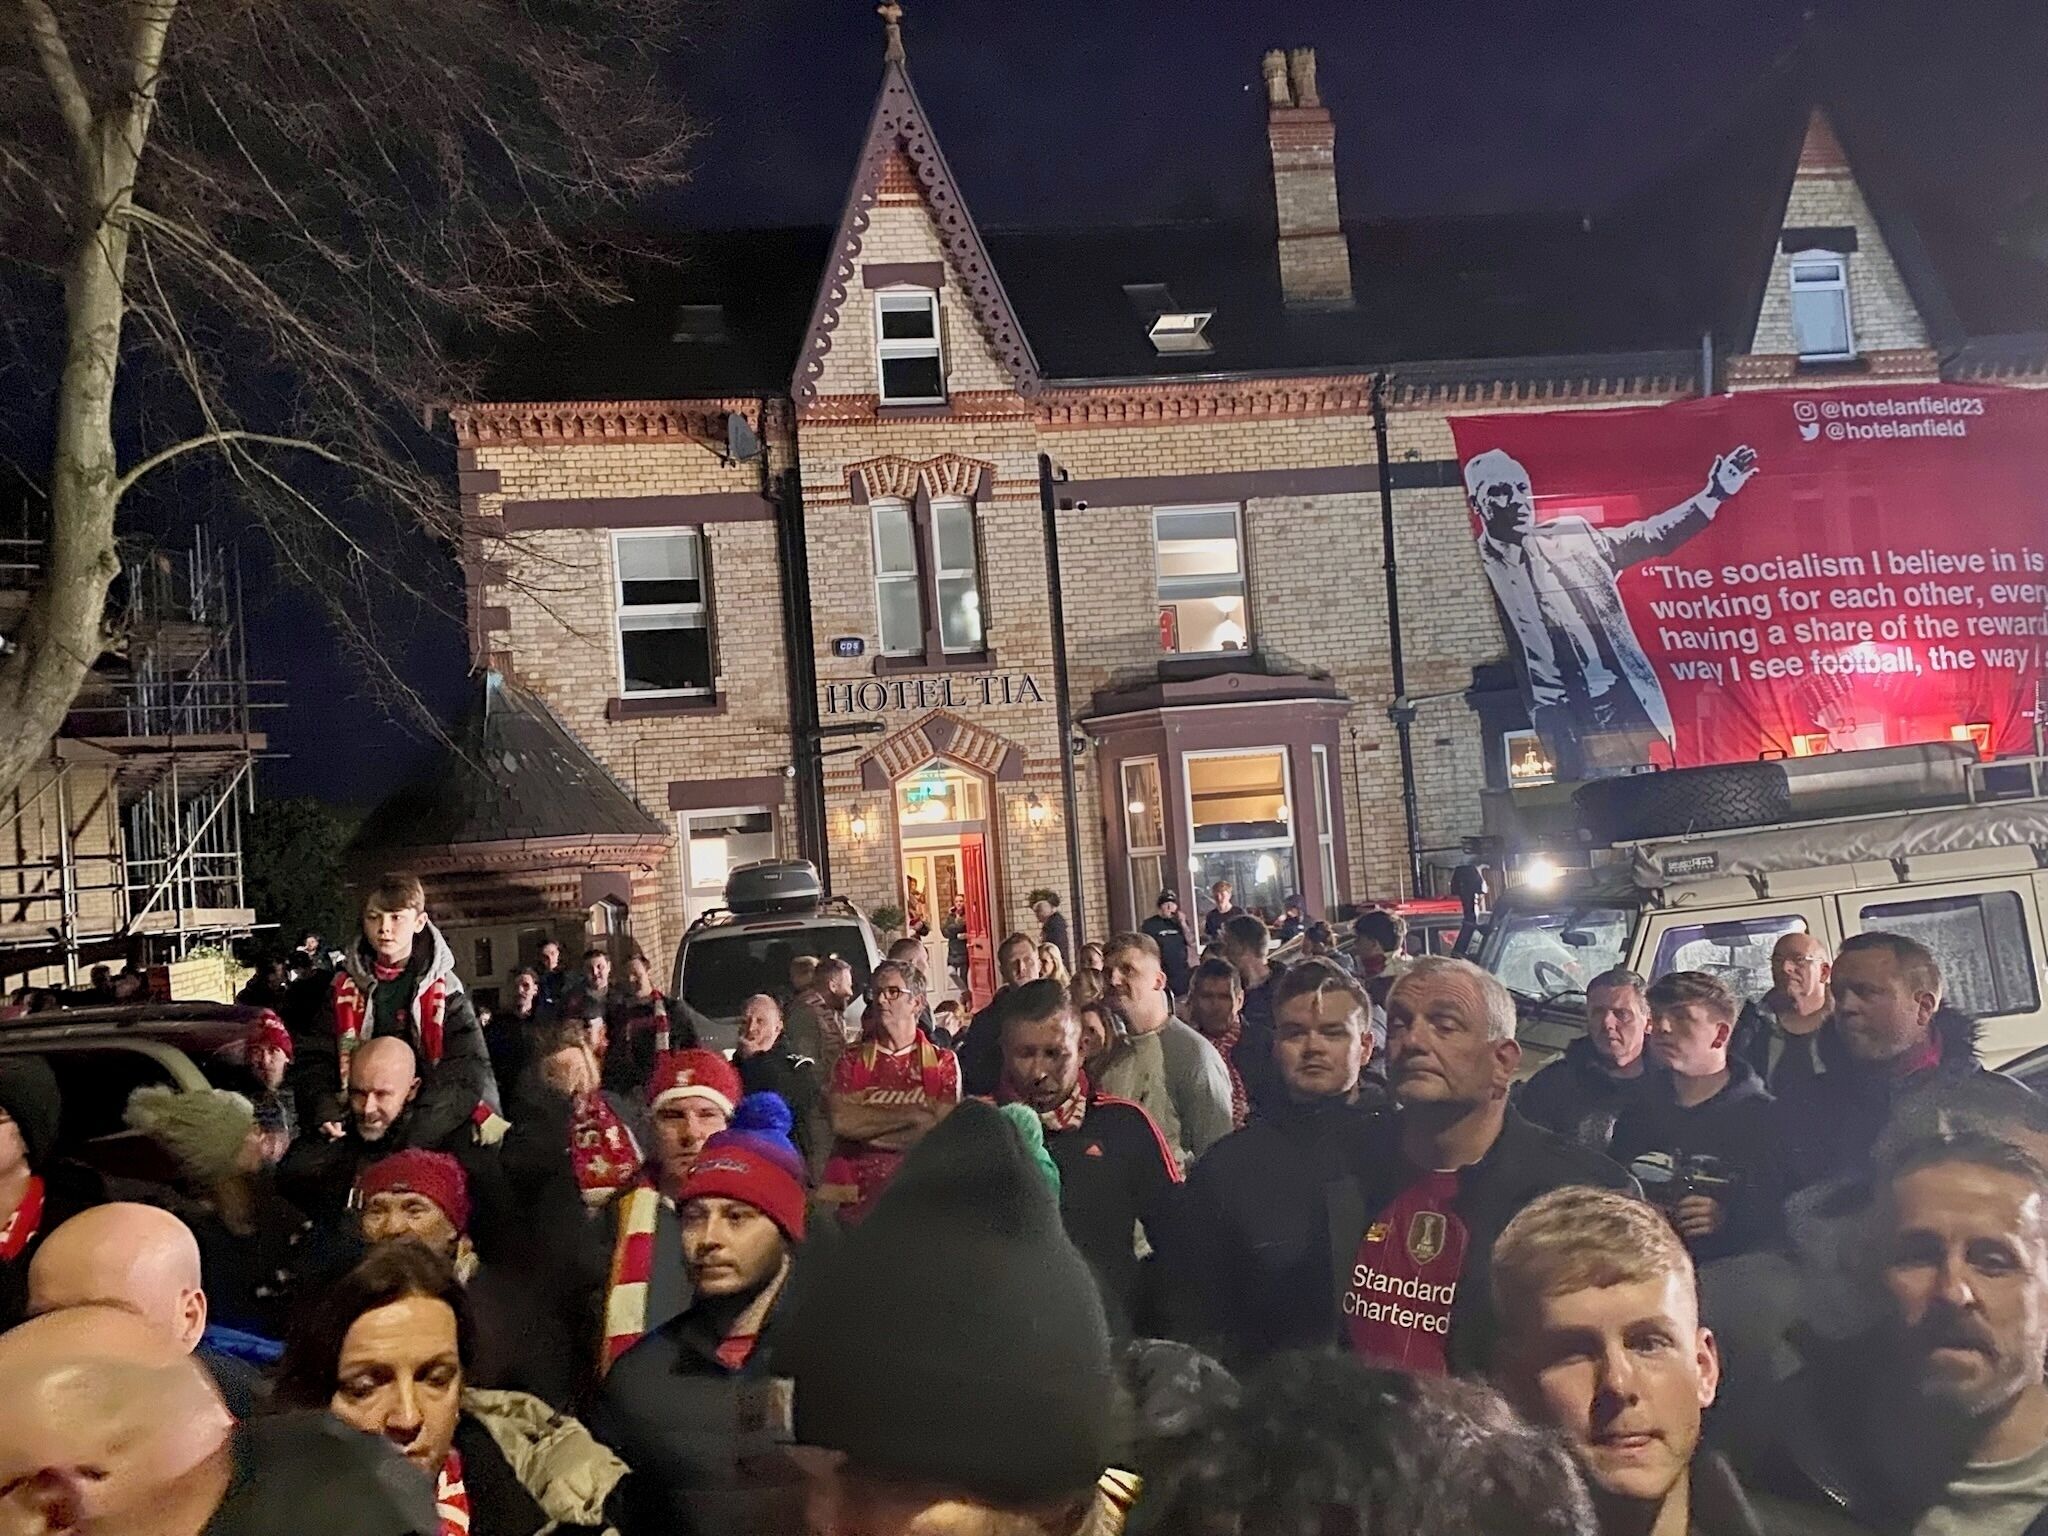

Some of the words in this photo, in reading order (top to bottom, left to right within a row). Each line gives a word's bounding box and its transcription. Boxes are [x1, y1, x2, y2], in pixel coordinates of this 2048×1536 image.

[1820, 397, 1985, 418] @hotelanfield23
[1825, 419, 1966, 440] @hotelanfield
[1641, 566, 1714, 589] “The
[1721, 553, 1865, 585] socialism
[1871, 551, 1881, 575] I
[1888, 549, 1985, 575] believe
[1990, 548, 2017, 572] in
[2022, 547, 2044, 572] is
[1649, 593, 1773, 620] working
[1778, 586, 1821, 612] for
[1829, 582, 1897, 609] each
[1903, 581, 1984, 609] other,
[1659, 626, 1759, 654] having
[1768, 625, 1787, 645] a
[1793, 617, 1874, 643] share
[1880, 614, 1907, 640] of
[1914, 613, 1960, 639] the
[1670, 660, 1724, 686] way
[1730, 657, 1741, 681] I
[1750, 655, 1804, 680] see
[1811, 646, 1922, 677] football,
[1928, 645, 1976, 670] the
[1981, 648, 2029, 674] way
[2034, 642, 2041, 667] I
[826, 677, 967, 714] HOTEL
[974, 672, 1045, 705] TIA
[1837, 717, 1856, 733] 23
[1352, 1264, 1456, 1305] Standard
[1342, 1291, 1451, 1334] Chartered
